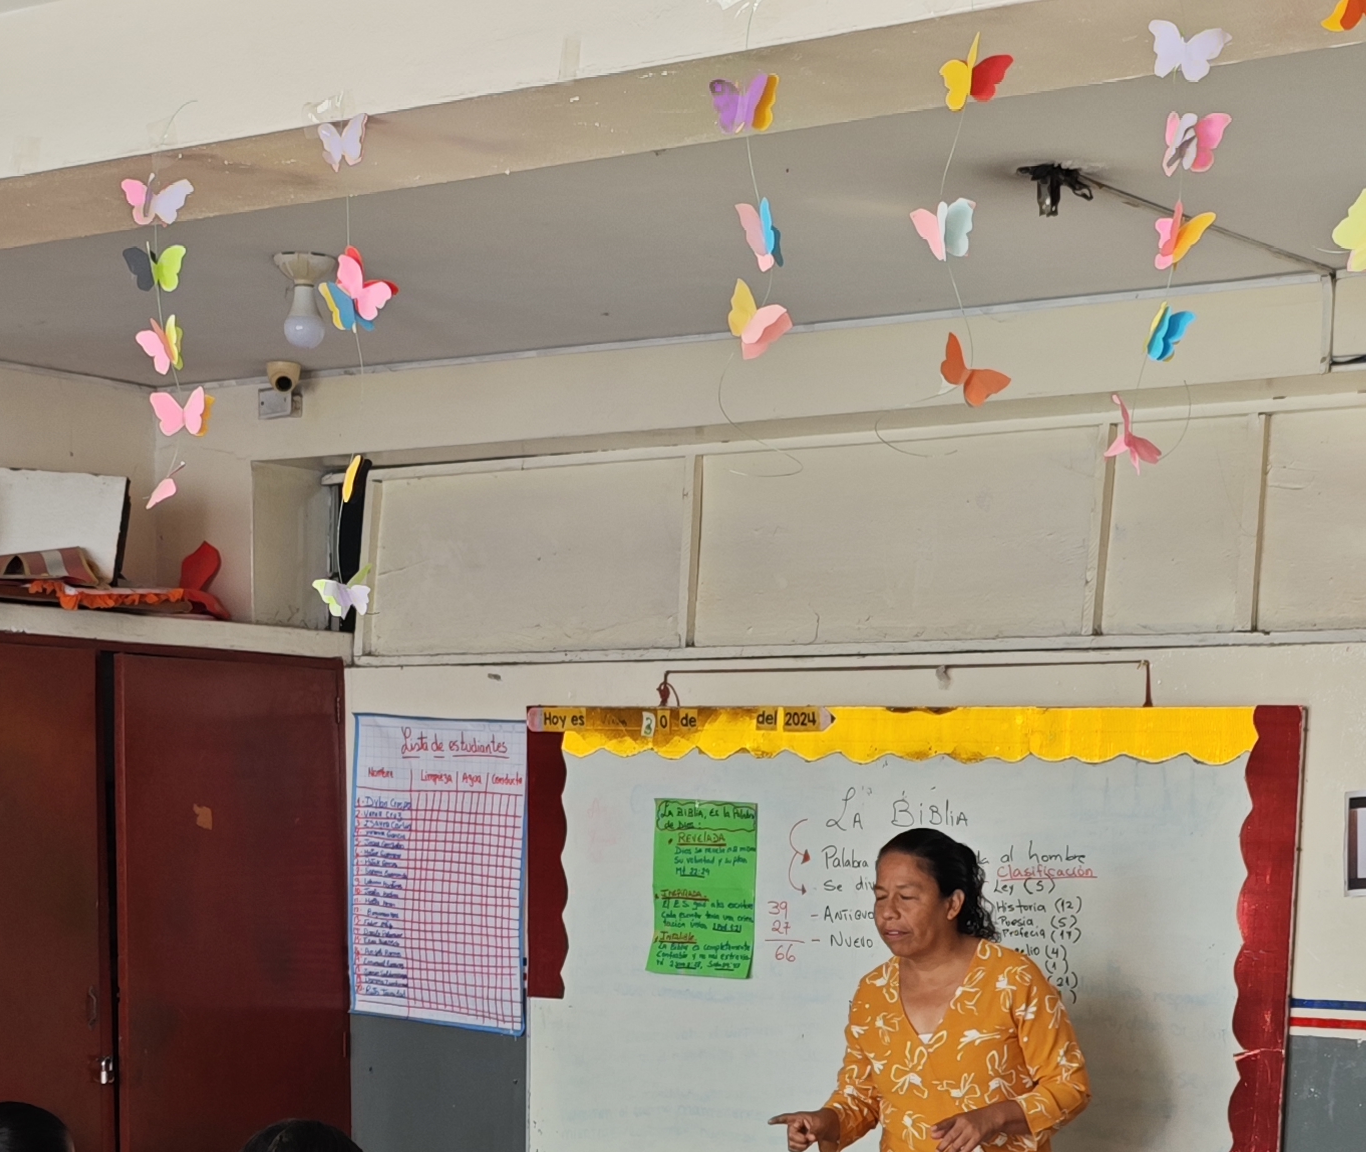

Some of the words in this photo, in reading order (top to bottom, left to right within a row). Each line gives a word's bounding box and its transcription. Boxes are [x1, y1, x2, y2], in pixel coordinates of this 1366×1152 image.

[543, 711, 566, 728] Hoy
[571, 715, 585, 726] es
[680, 713, 697, 727] de
[756, 710, 778, 725] del
[785, 711, 816, 726] 2024
[401, 726, 428, 754] Lista
[431, 733, 444, 752] de
[449, 731, 508, 754] estudiantes
[821, 845, 869, 869] Palabra
[1001, 845, 1013, 863] al
[1029, 840, 1086, 864] hombre
[997, 864, 1094, 879] Clasificación
[823, 880, 843, 891] Se
[994, 879, 1013, 895] Ley
[1024, 874, 1055, 894] (5)
[767, 900, 788, 919] 39
[996, 899, 1046, 913] Historia
[1055, 896, 1082, 913] (12)
[771, 920, 791, 935] 27
[1050, 915, 1077, 929] (5)
[775, 944, 796, 962] 66
[1045, 944, 1067, 959] (4)
